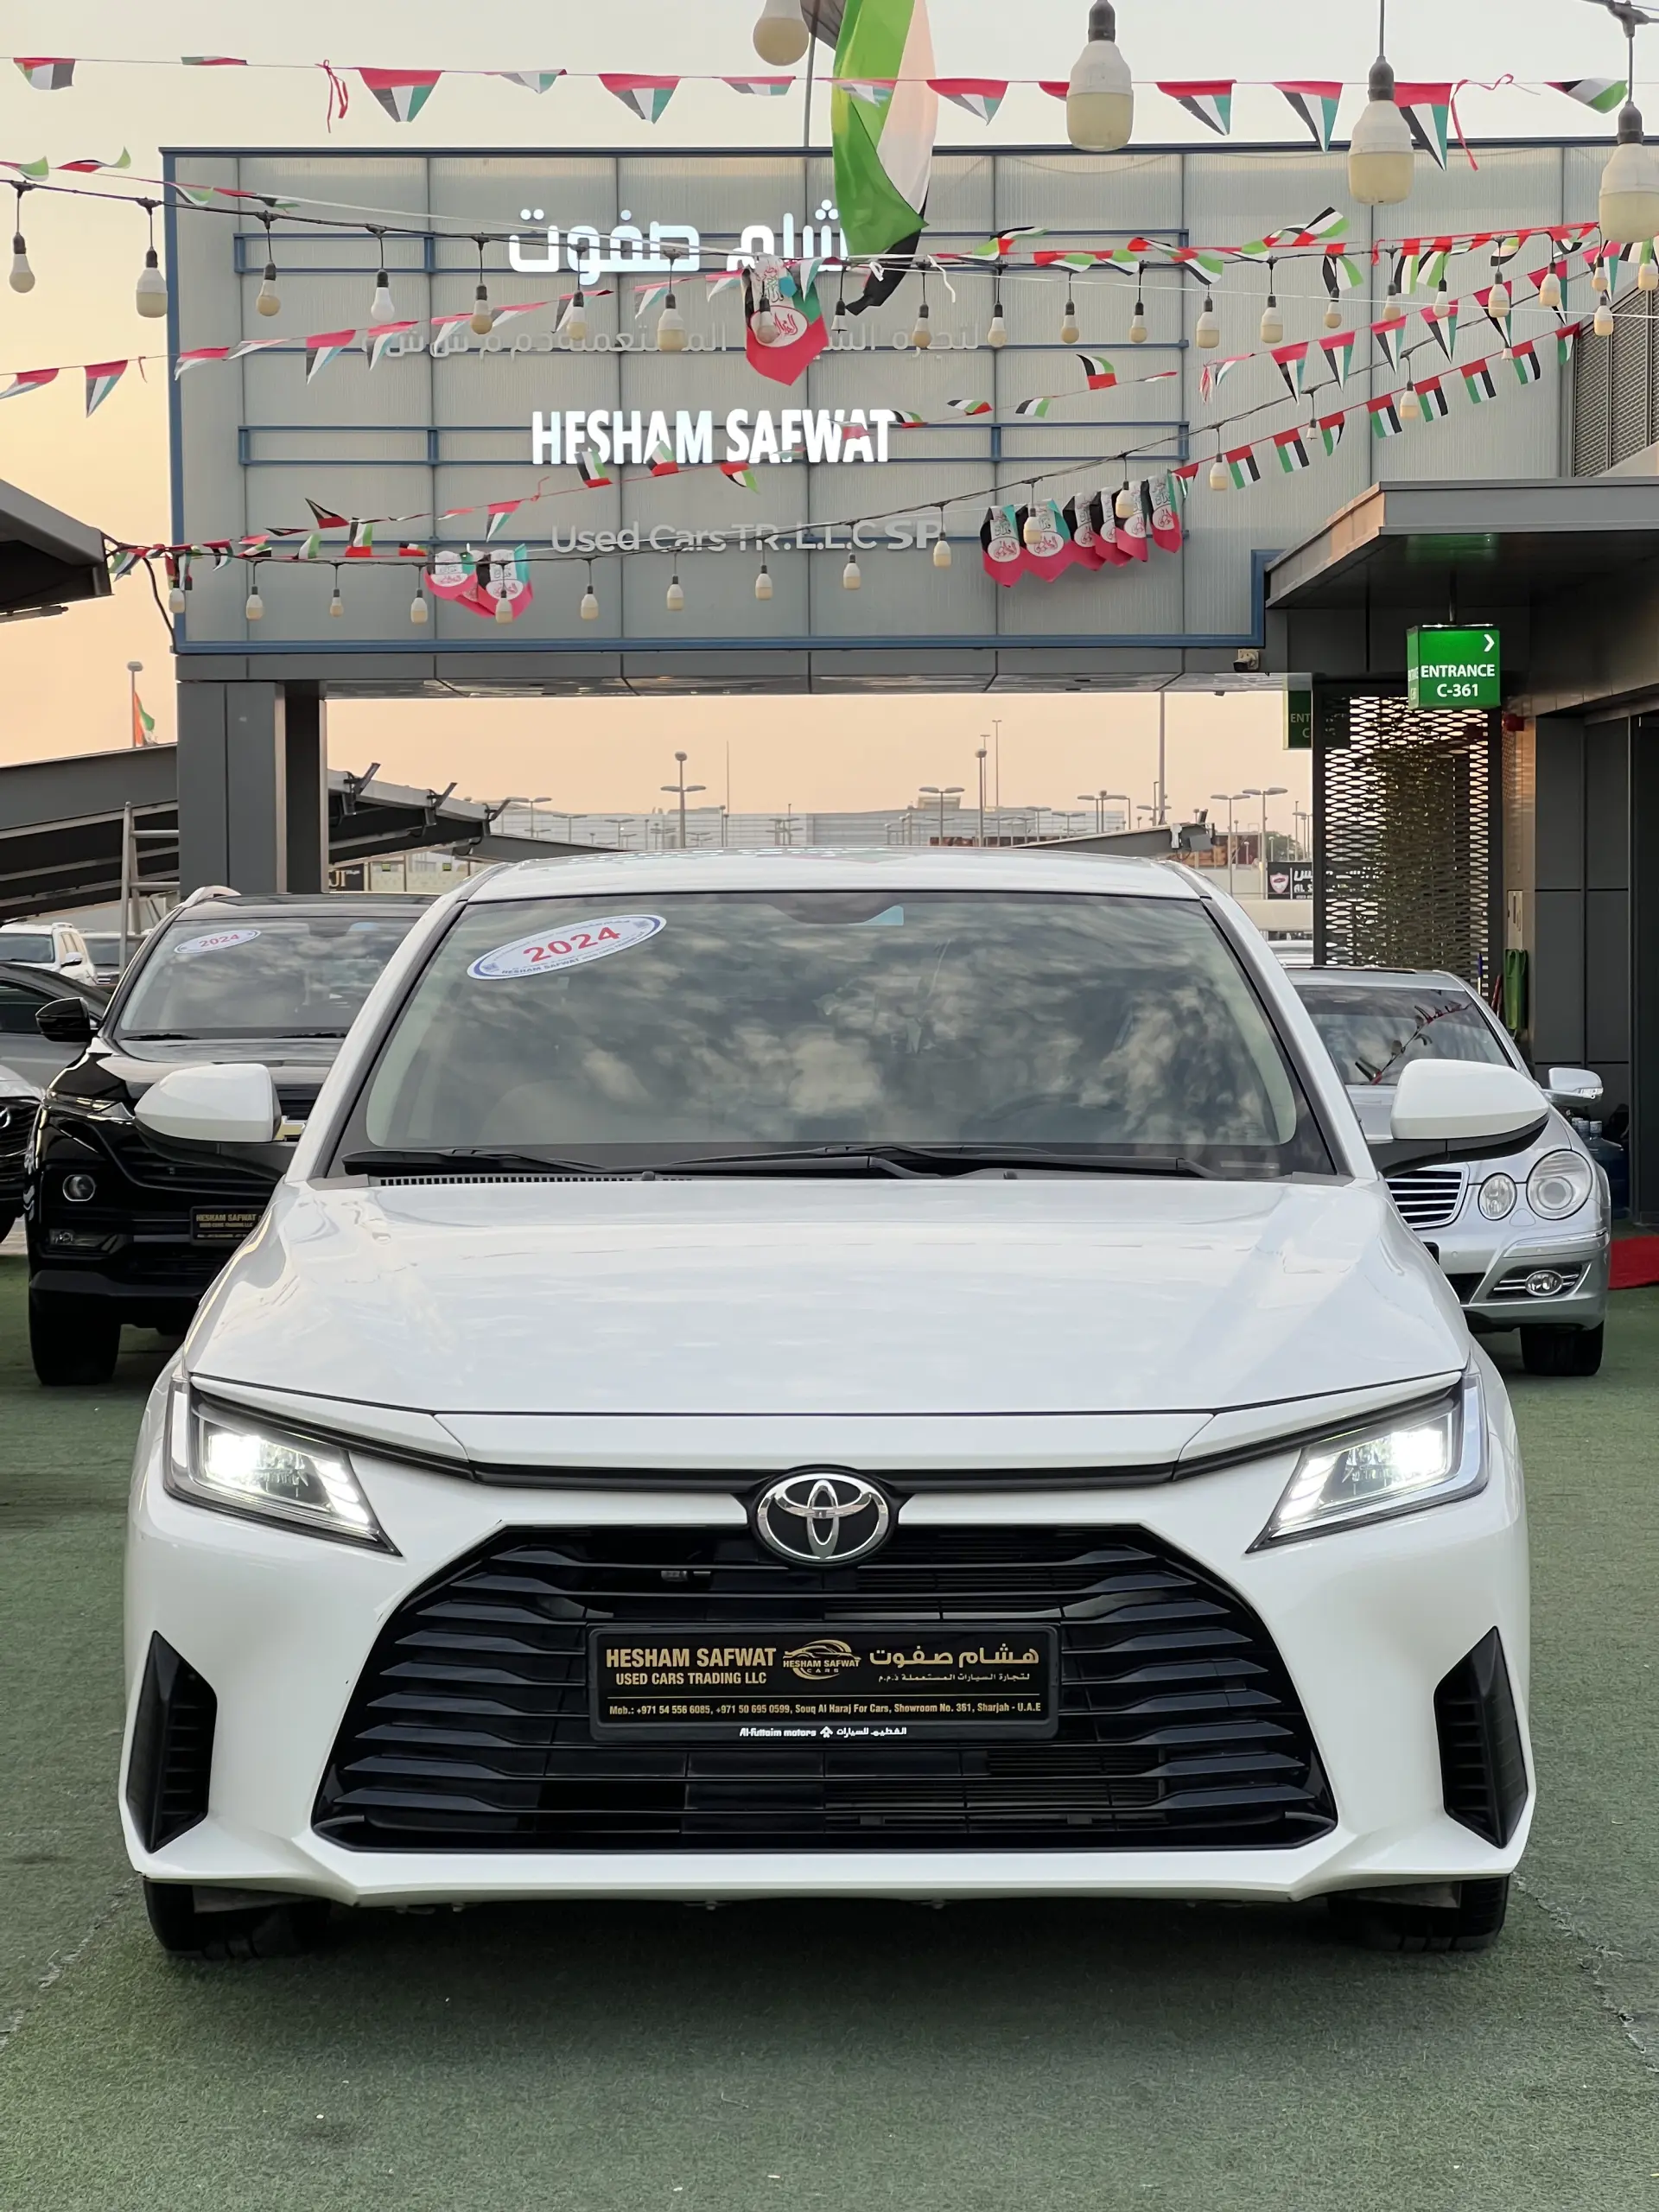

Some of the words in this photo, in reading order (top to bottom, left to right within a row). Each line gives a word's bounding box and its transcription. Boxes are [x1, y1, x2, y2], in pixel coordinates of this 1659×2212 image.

[727, 199, 850, 271] شام
[509, 208, 701, 285] صفوت
[532, 410, 713, 465] HESHAM
[726, 409, 897, 463] SAFWAT
[551, 522, 639, 554] Used
[650, 523, 727, 553] Cars
[1421, 664, 1496, 678] ENTRANCE
[1436, 683, 1479, 697] C-361
[199, 934, 240, 947] 2024
[523, 926, 622, 963] 2024
[606, 1649, 690, 1668] HESHAM
[696, 1648, 777, 1667] SAFWAT
[869, 1645, 954, 1669] صفوت
[958, 1643, 1039, 1669] هشام
[823, 1659, 860, 1668] SAFWAT
[616, 1673, 647, 1685] USED
[652, 1673, 684, 1685] CARS
[688, 1672, 741, 1684] TRADING
[745, 1672, 767, 1684] LLC
[901, 1673, 956, 1681] المستعملة
[957, 1673, 996, 1682] السيارات
[998, 1673, 1030, 1682] لتجارة
[609, 1705, 635, 1715] Mob.:
[637, 1705, 657, 1714] +971
[658, 1705, 670, 1714] 54
[671, 1705, 688, 1714] 556
[689, 1705, 714, 1715] 6085,
[716, 1705, 736, 1714] +971
[739, 1705, 749, 1713] 50
[751, 1704, 767, 1713] 695
[769, 1704, 793, 1714] 0599,
[795, 1704, 817, 1715] Souq
[817, 1704, 827, 1713] Al
[829, 1704, 852, 1714] Haraj
[854, 1704, 868, 1713] For
[869, 1704, 893, 1714] Cars,
[893, 1703, 938, 1713] Showroom
[939, 1703, 954, 1713] No.
[956, 1703, 976, 1713] 361,
[977, 1702, 1010, 1713] Sharjah
[1017, 1702, 1041, 1712] U.A.E
[739, 1727, 782, 1737] Al-Futtaim
[783, 1728, 817, 1737] motors
